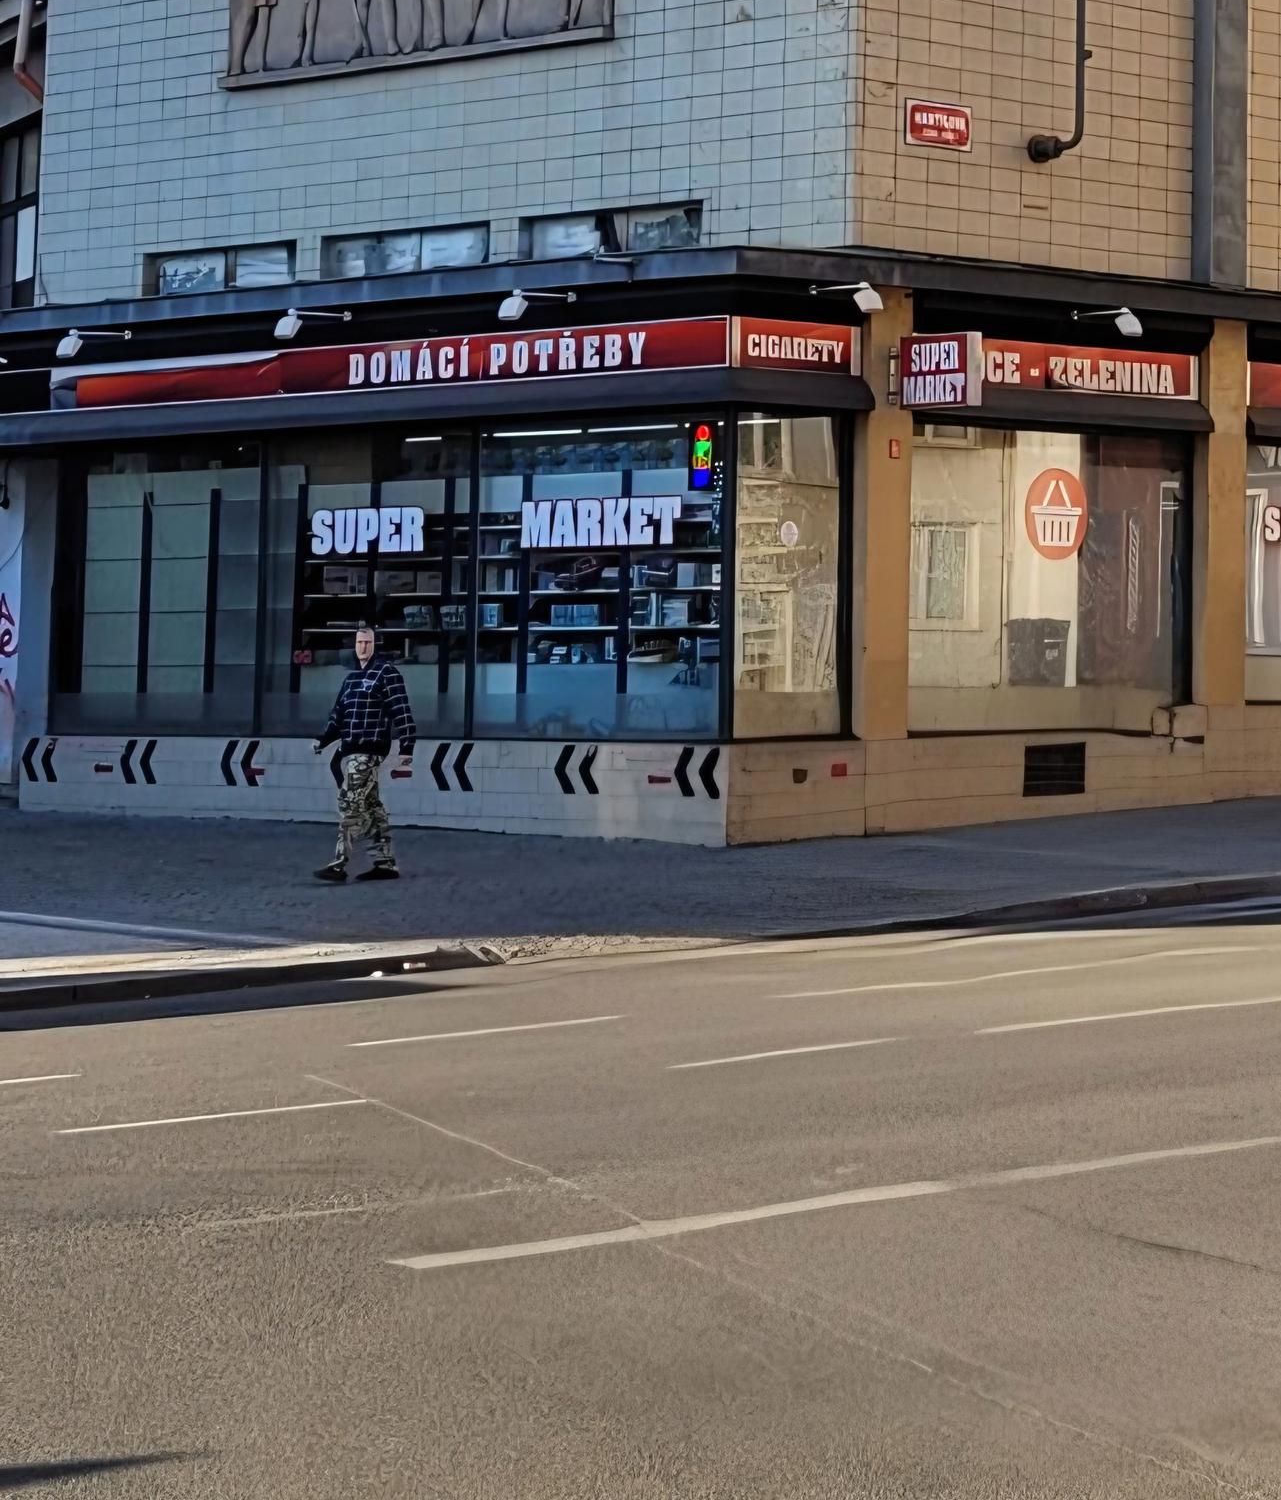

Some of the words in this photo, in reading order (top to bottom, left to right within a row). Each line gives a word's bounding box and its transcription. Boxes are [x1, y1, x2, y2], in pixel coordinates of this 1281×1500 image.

[348, 337, 470, 385] DOMÁCÍ
[489, 330, 647, 375] POTŘEBY
[746, 333, 845, 364] CIGARETY
[910, 340, 959, 372] SUPER
[903, 372, 966, 405] MARKET
[1049, 356, 1176, 396] ZELENINA
[311, 506, 425, 556] SUPER
[520, 494, 683, 549] MARKET
